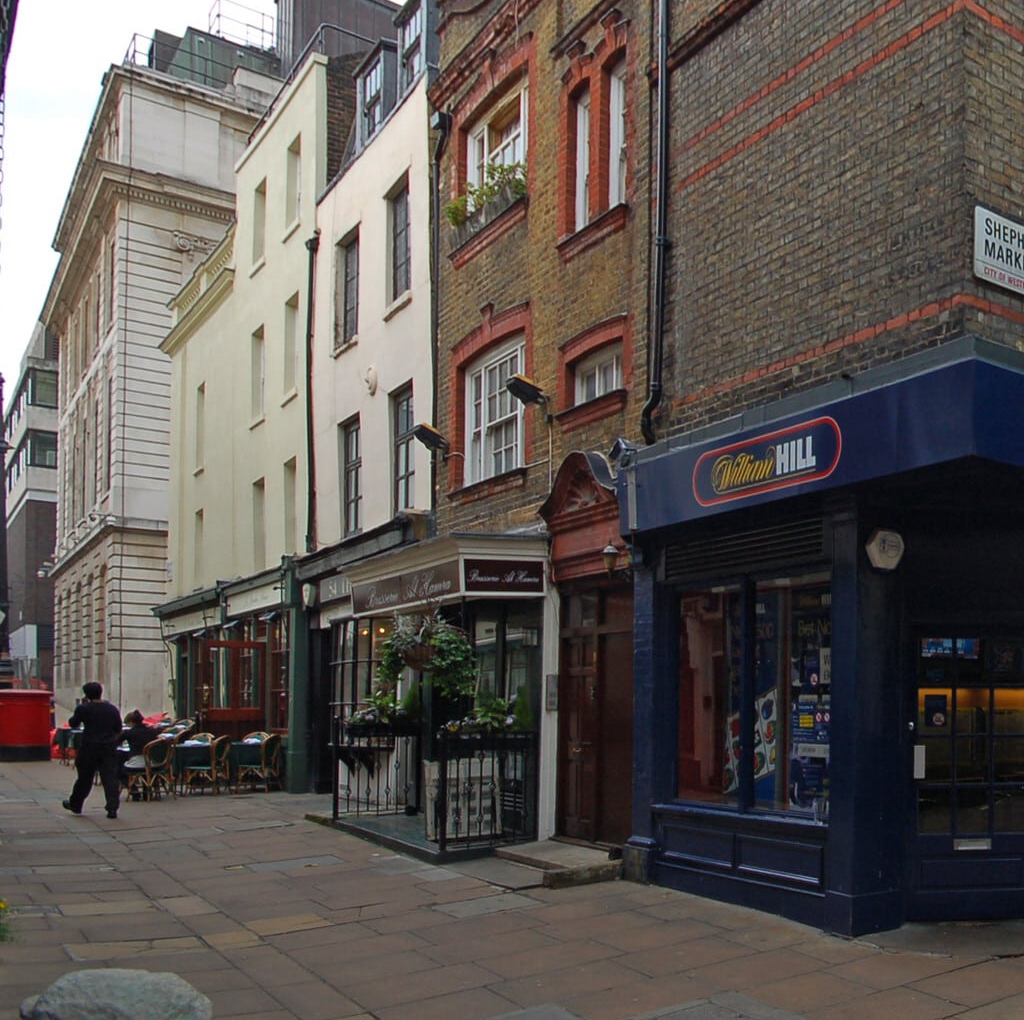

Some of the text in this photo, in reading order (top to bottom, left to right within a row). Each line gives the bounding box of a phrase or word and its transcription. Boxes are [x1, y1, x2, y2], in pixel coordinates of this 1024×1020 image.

[984, 266, 998, 278] CITY
[999, 271, 1006, 281] OF
[711, 435, 816, 493] William HILL
